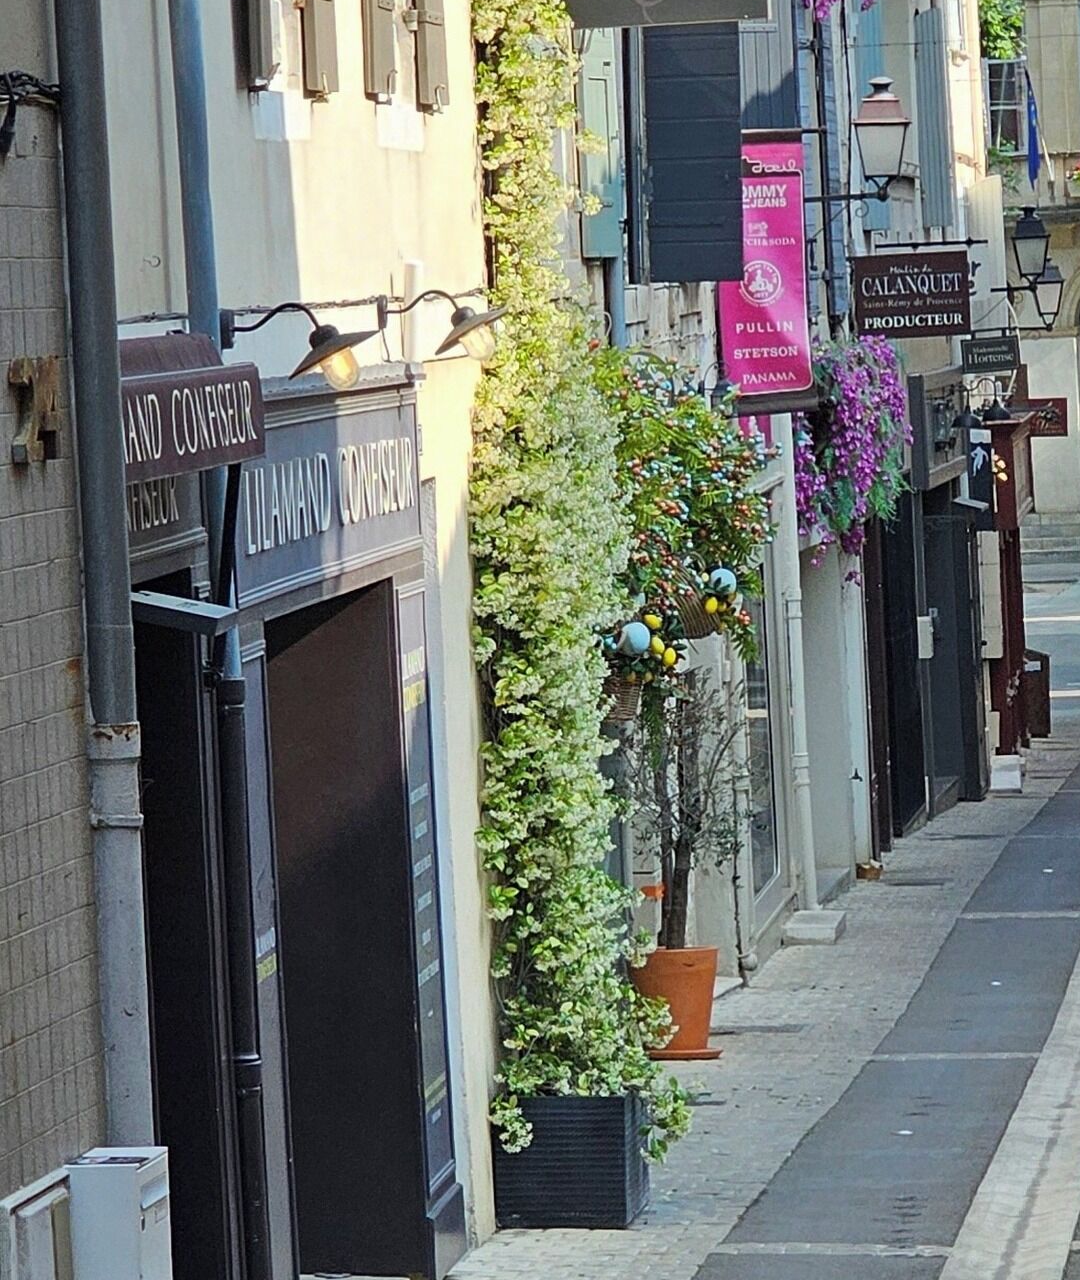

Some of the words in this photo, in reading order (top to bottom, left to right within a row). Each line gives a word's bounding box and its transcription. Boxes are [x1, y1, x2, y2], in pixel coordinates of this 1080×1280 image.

[750, 198, 787, 208] JEANS
[861, 272, 962, 297] CALANQUET
[736, 321, 793, 334] PULLIN
[864, 312, 964, 329] PRODUCTEUR
[734, 346, 799, 360] STETSON
[968, 353, 1014, 365] Hortense
[743, 372, 797, 385] PANAMA
[171, 380, 258, 456] CONFISEUR
[243, 452, 332, 555] LILAMAND
[337, 436, 415, 526] CONFISEUR
